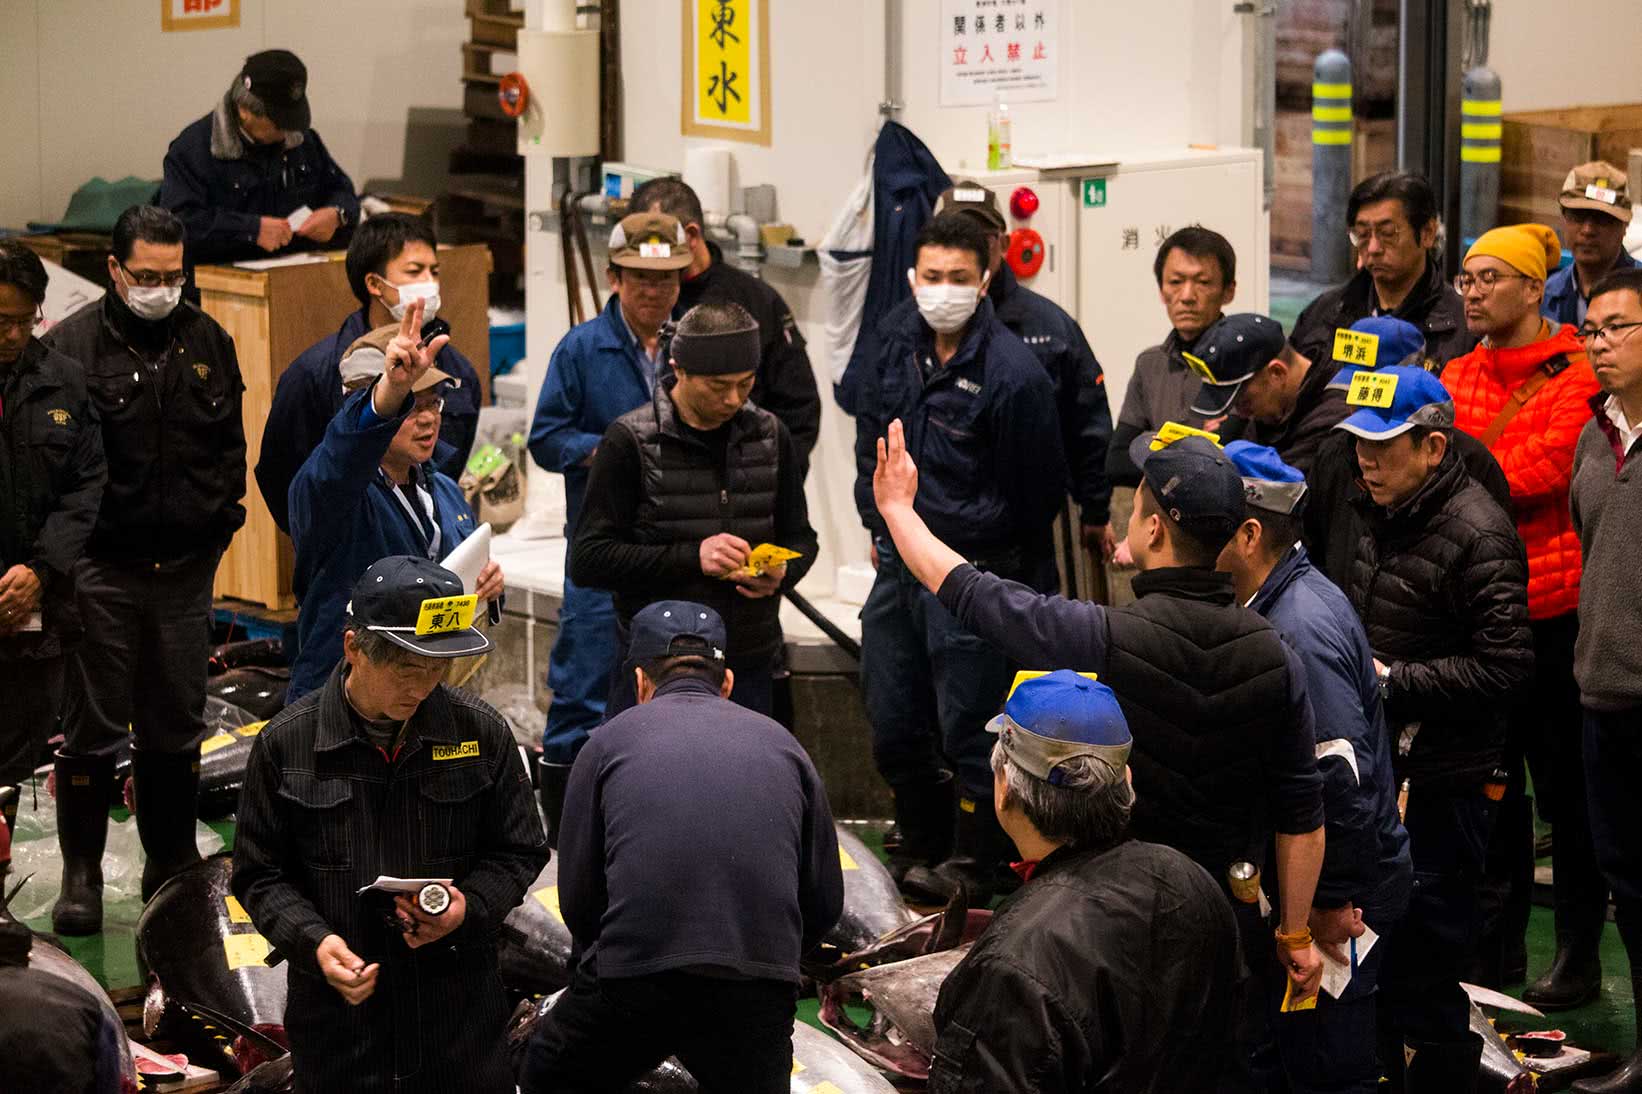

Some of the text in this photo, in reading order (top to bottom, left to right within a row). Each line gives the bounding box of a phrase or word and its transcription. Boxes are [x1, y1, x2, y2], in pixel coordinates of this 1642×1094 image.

[953, 41, 1047, 65] 立入禁止
[429, 611, 461, 630] 東八
[433, 743, 478, 758] TOUHACHI
